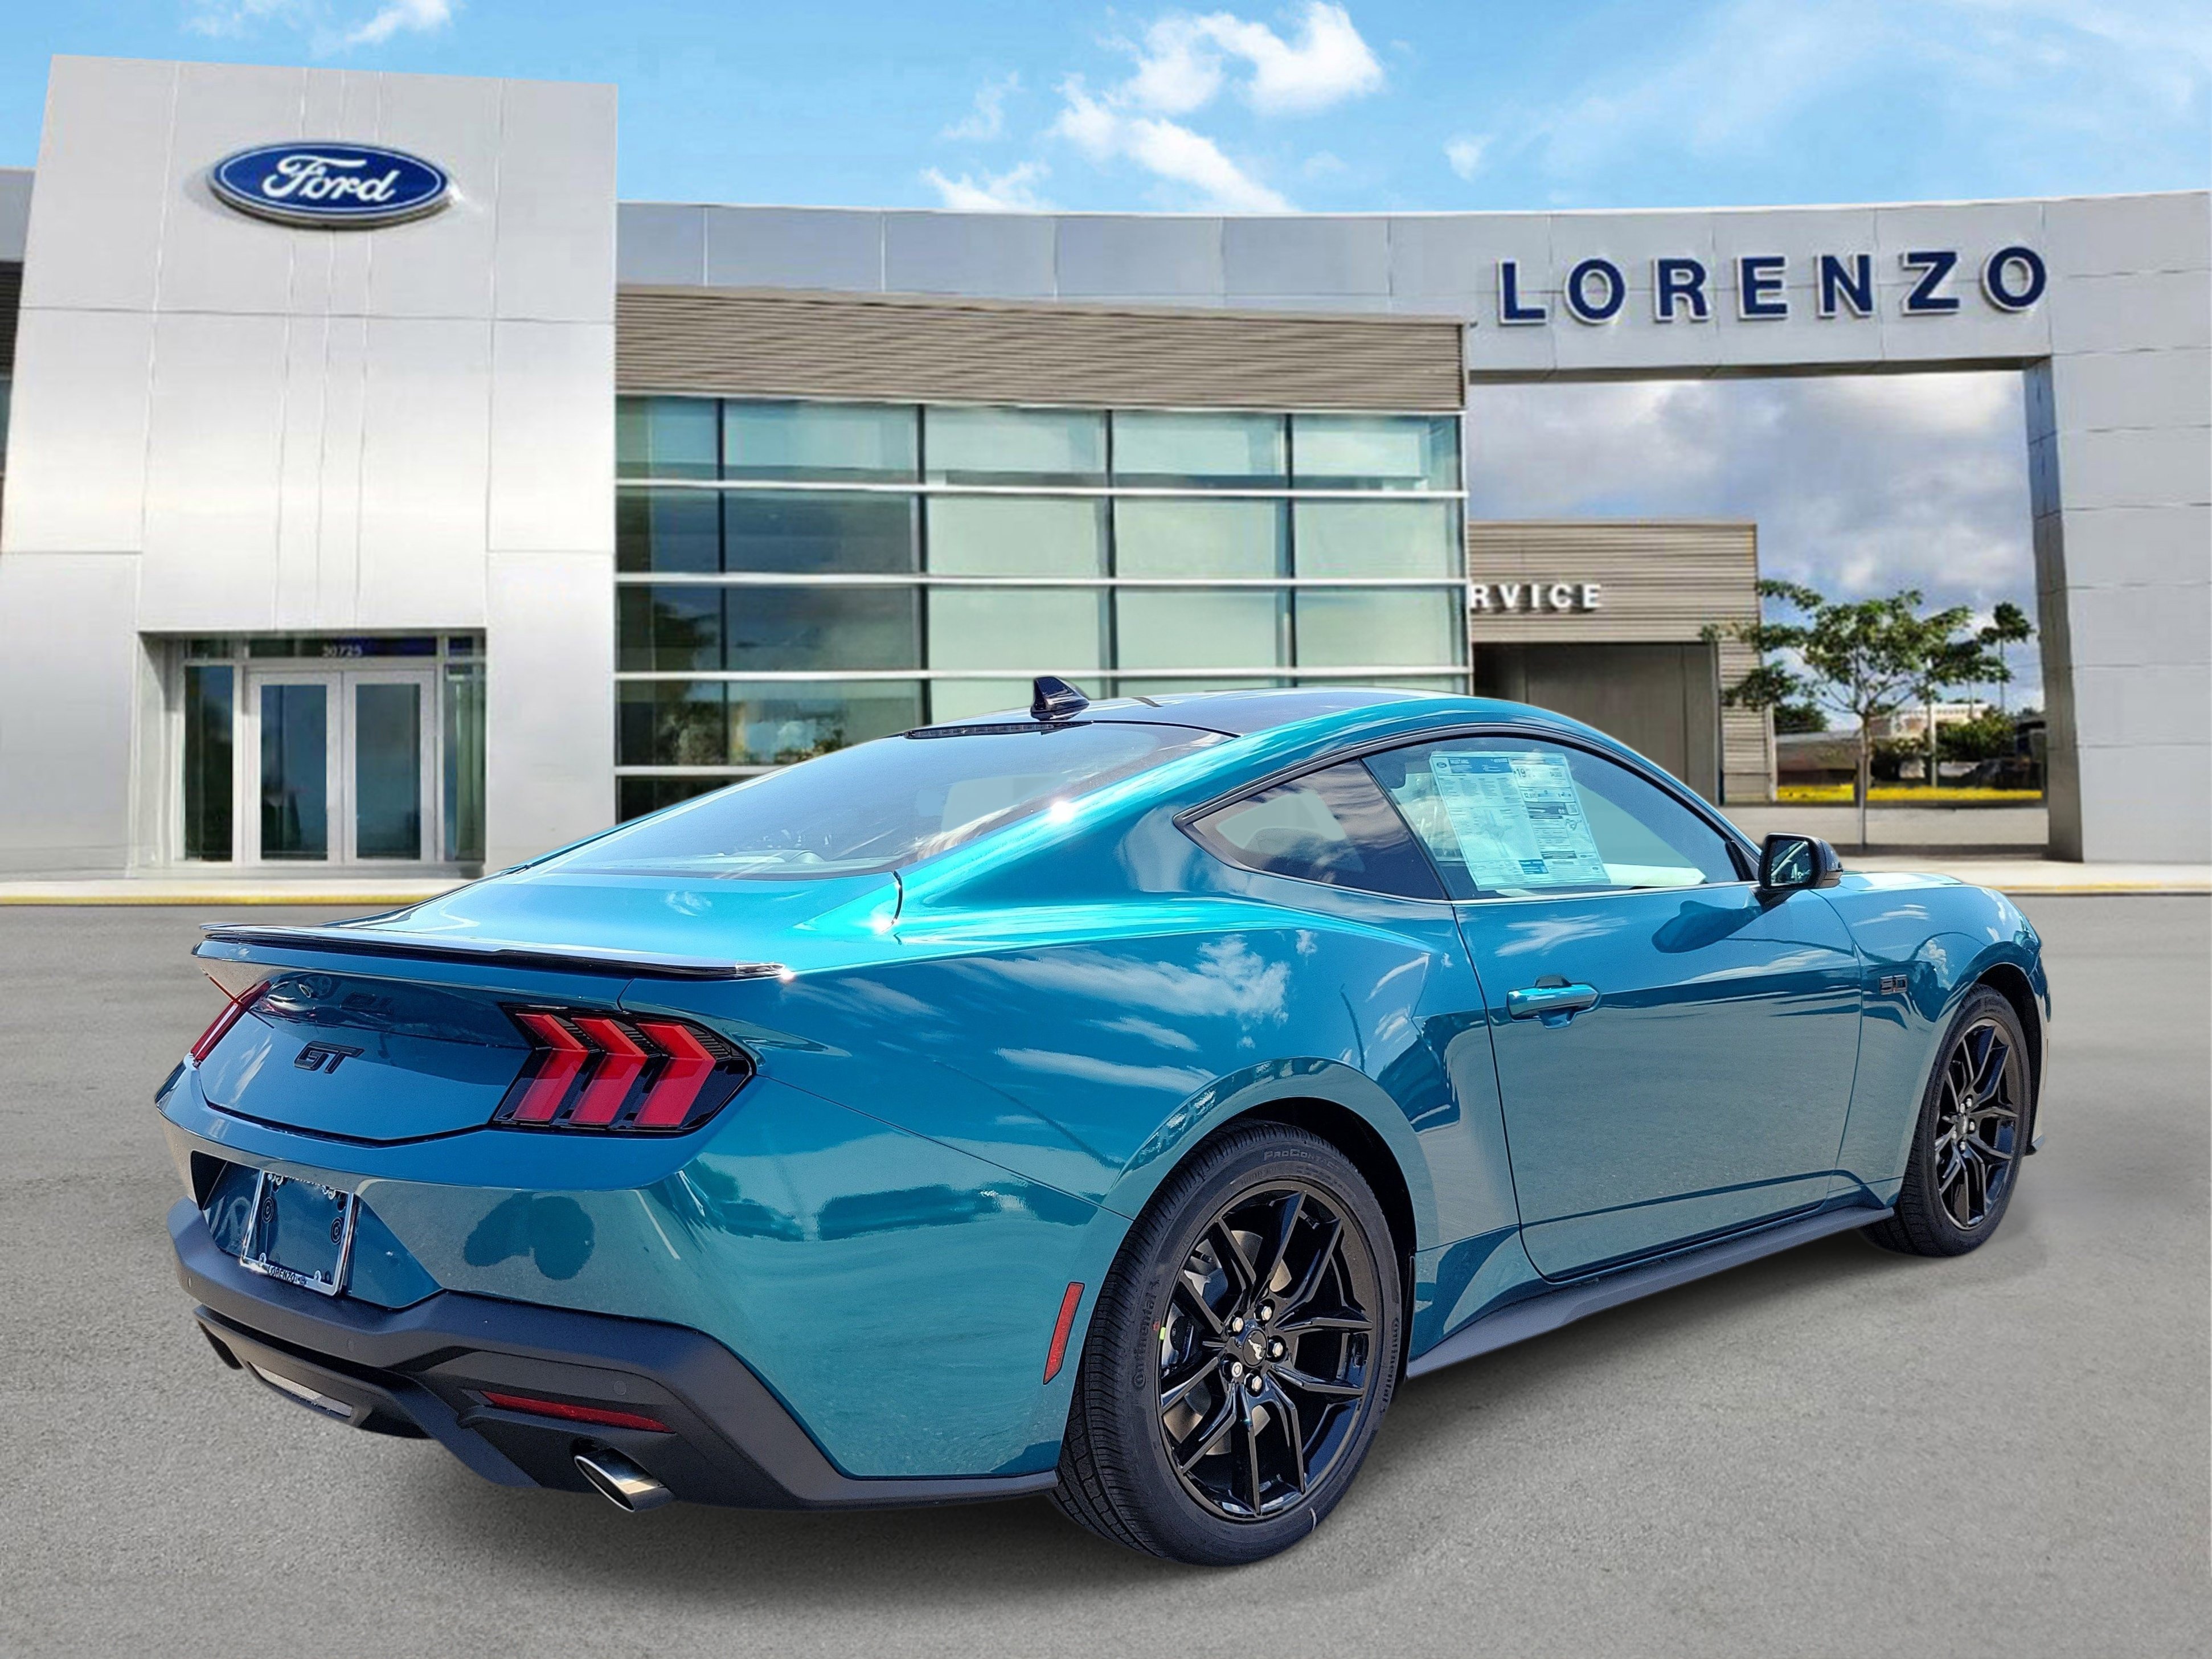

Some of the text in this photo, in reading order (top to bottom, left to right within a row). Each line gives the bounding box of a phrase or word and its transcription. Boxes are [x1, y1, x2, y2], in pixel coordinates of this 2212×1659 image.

[262, 154, 400, 202] Ford
[1497, 245, 2049, 325] LORENZO
[1469, 583, 1603, 609] RVICE
[294, 1041, 366, 1075] GT
[268, 1265, 297, 1284] LORENZO
